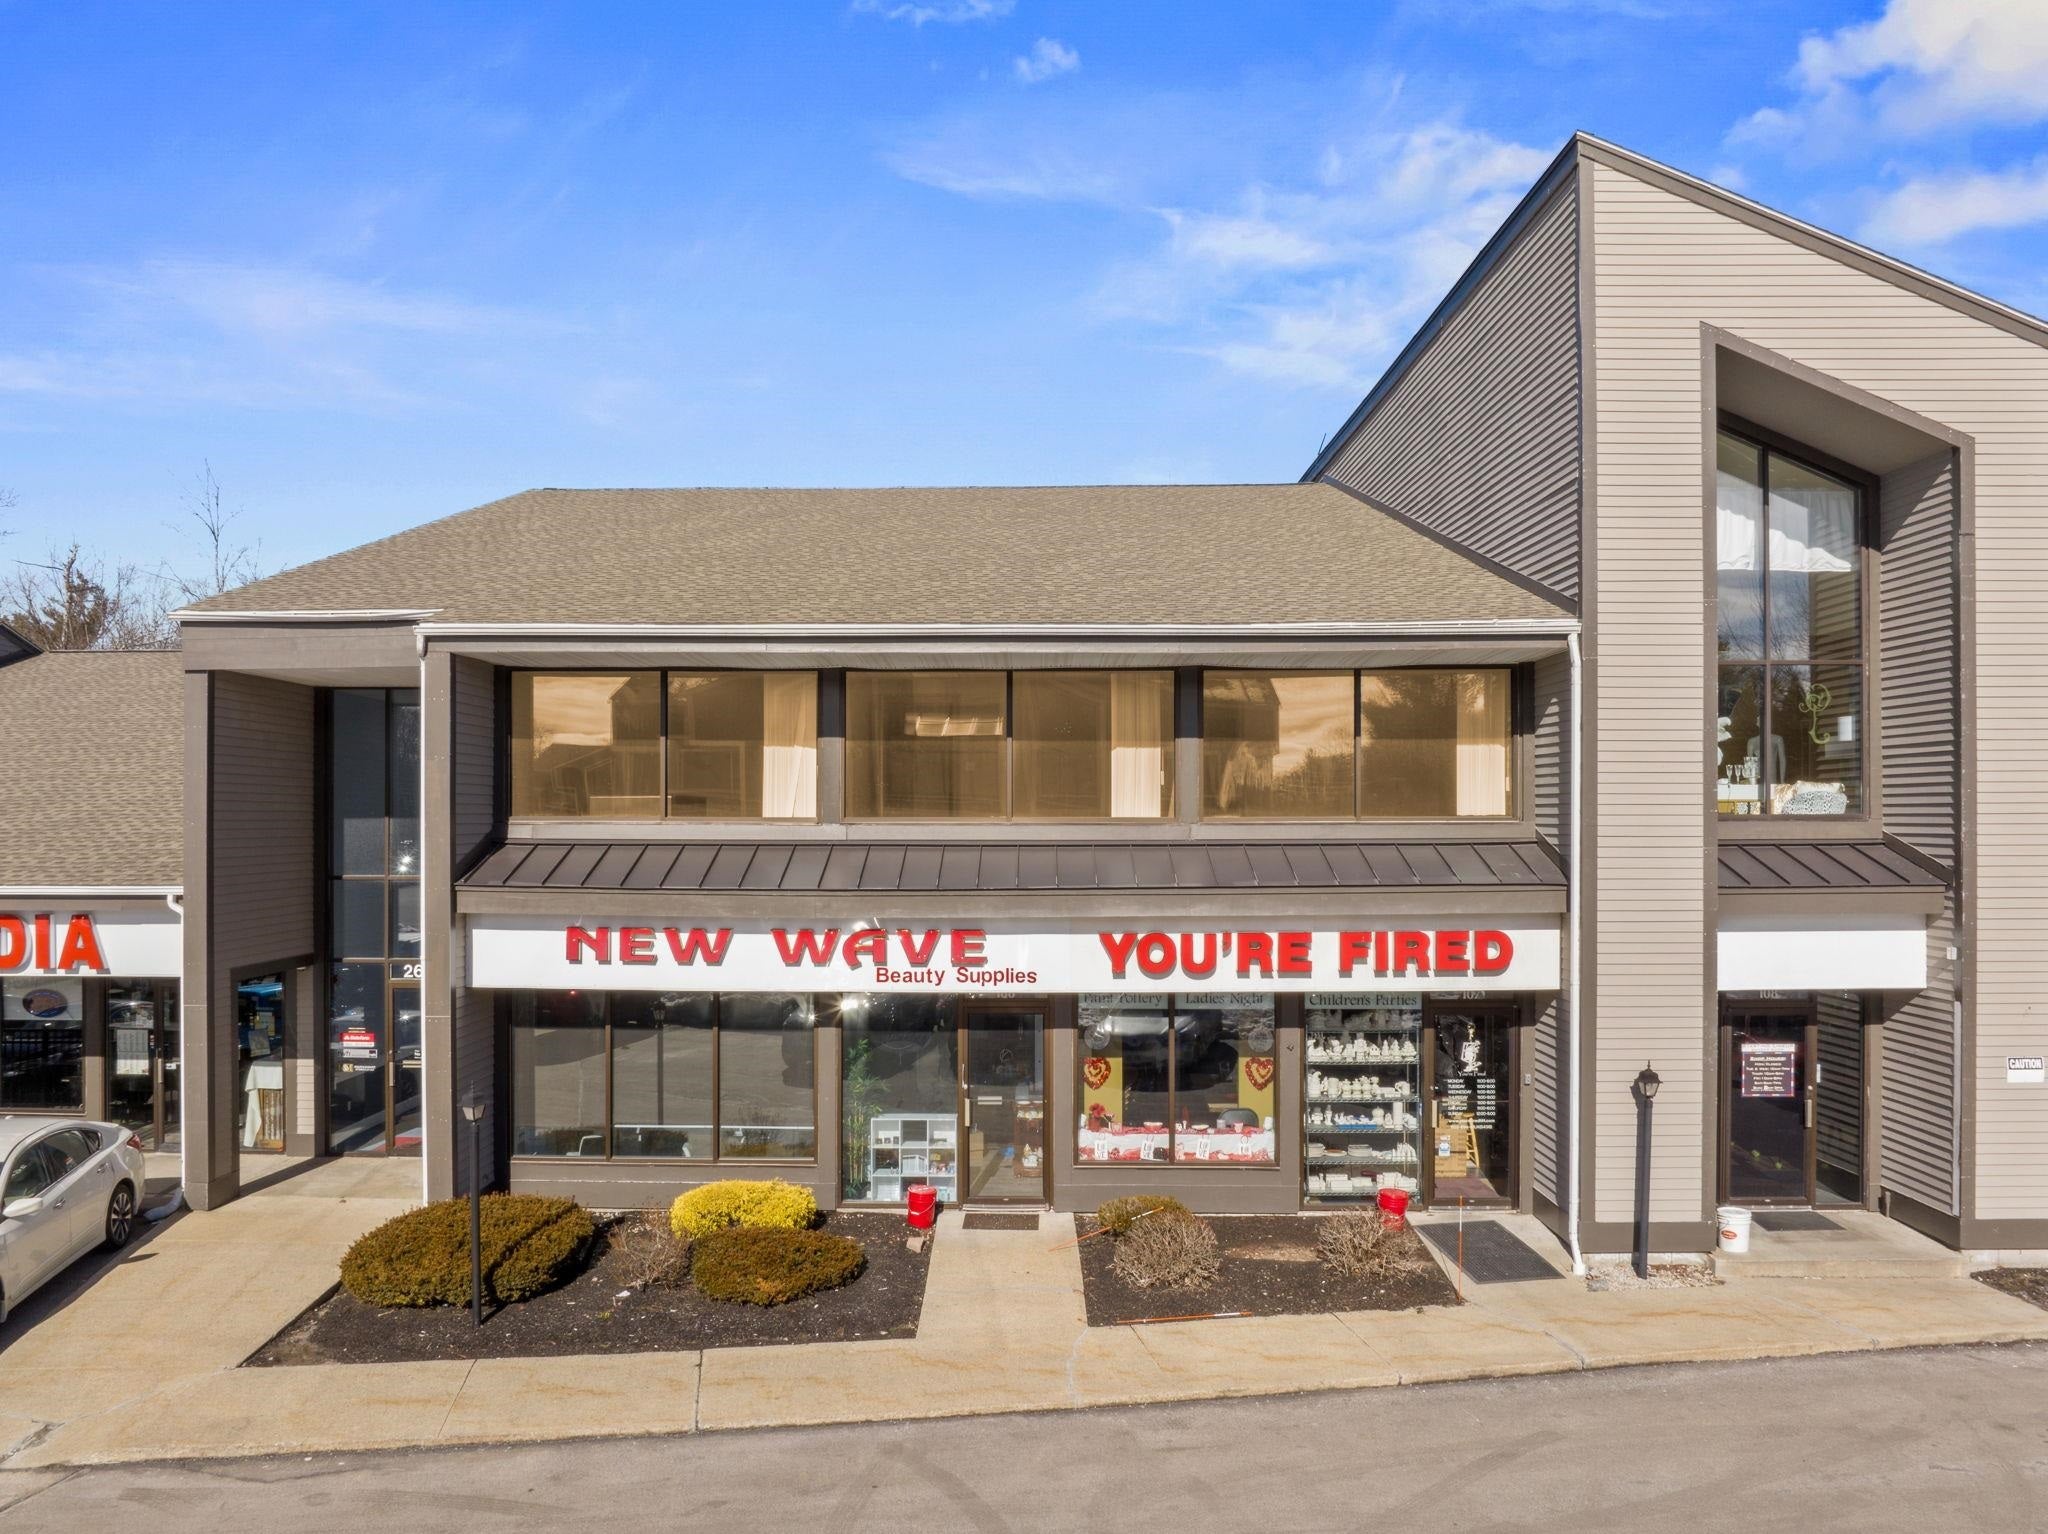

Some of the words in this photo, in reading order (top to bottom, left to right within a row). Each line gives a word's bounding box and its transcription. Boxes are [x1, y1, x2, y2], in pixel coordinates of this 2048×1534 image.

[566, 926, 734, 964] NEW
[771, 928, 989, 968] WAVE
[1098, 931, 1314, 976] YOU'RE
[1339, 930, 1514, 974] FIRED
[876, 967, 946, 986] Beauty
[956, 966, 1037, 986] Supplies
[1119, 992, 1163, 1007] Pottery
[1185, 992, 1226, 1004] Ladies
[1229, 992, 1264, 1006] Night
[1309, 993, 1371, 1006] Children's
[1376, 993, 1417, 1006] Parties
[2009, 1058, 2042, 1069] CAUTION
